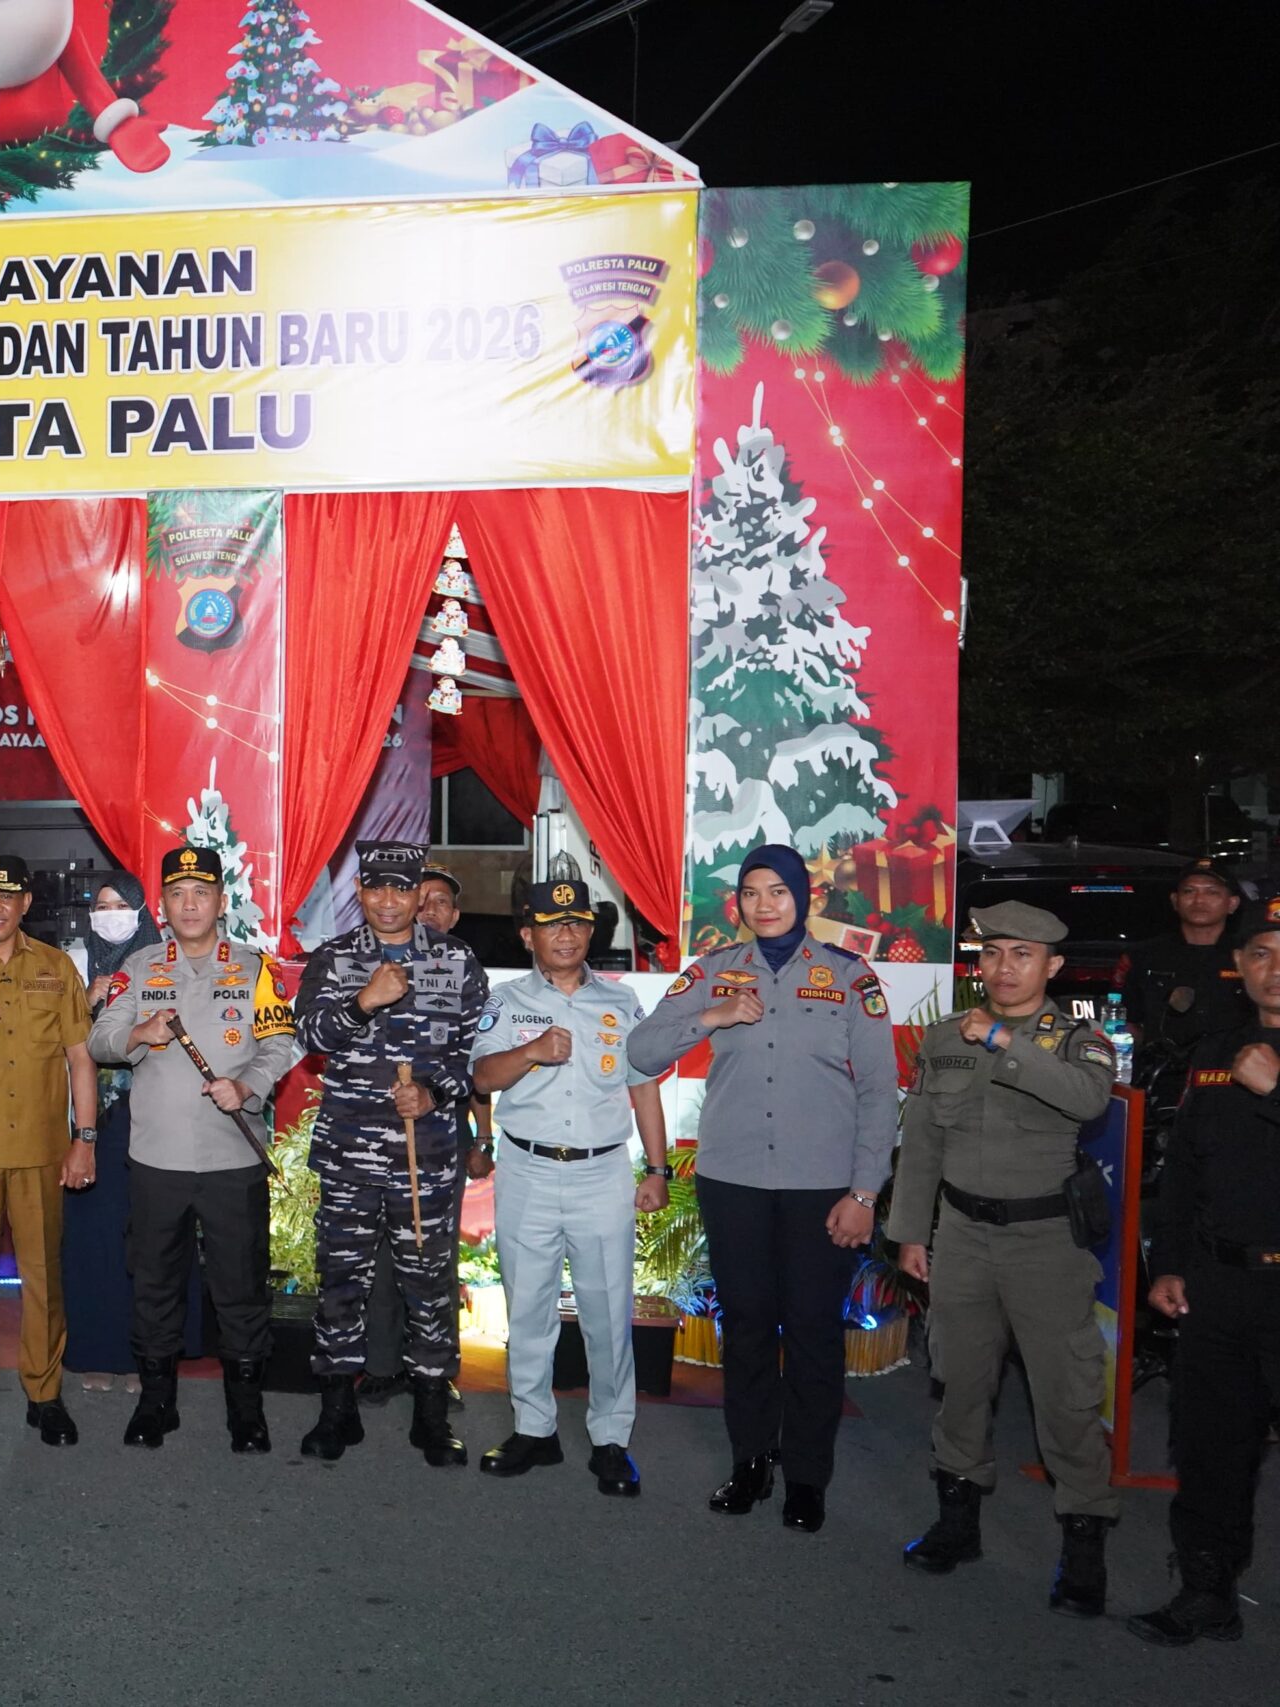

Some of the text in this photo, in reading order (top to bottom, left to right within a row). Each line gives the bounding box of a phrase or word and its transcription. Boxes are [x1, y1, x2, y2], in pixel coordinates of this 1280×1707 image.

[566, 258, 658, 276] POLRESTA PALU
[573, 281, 652, 297] SULAWESI TENGAH
[102, 313, 261, 371] TAHUN
[281, 307, 410, 368] BARU
[426, 303, 541, 361] 2026
[111, 394, 312, 454] PALU
[168, 528, 254, 544] POLRESTA PALU
[174, 551, 248, 566] SULAWESI TENGAH
[383, 732, 403, 748] 26
[418, 978, 459, 990] TNI AL
[141, 990, 177, 1001] ENDI.S
[213, 989, 250, 1000] POLRI
[800, 989, 843, 1002] DISHUB
[1072, 1000, 1096, 1019] DN
[511, 1014, 554, 1025] SUGENG
